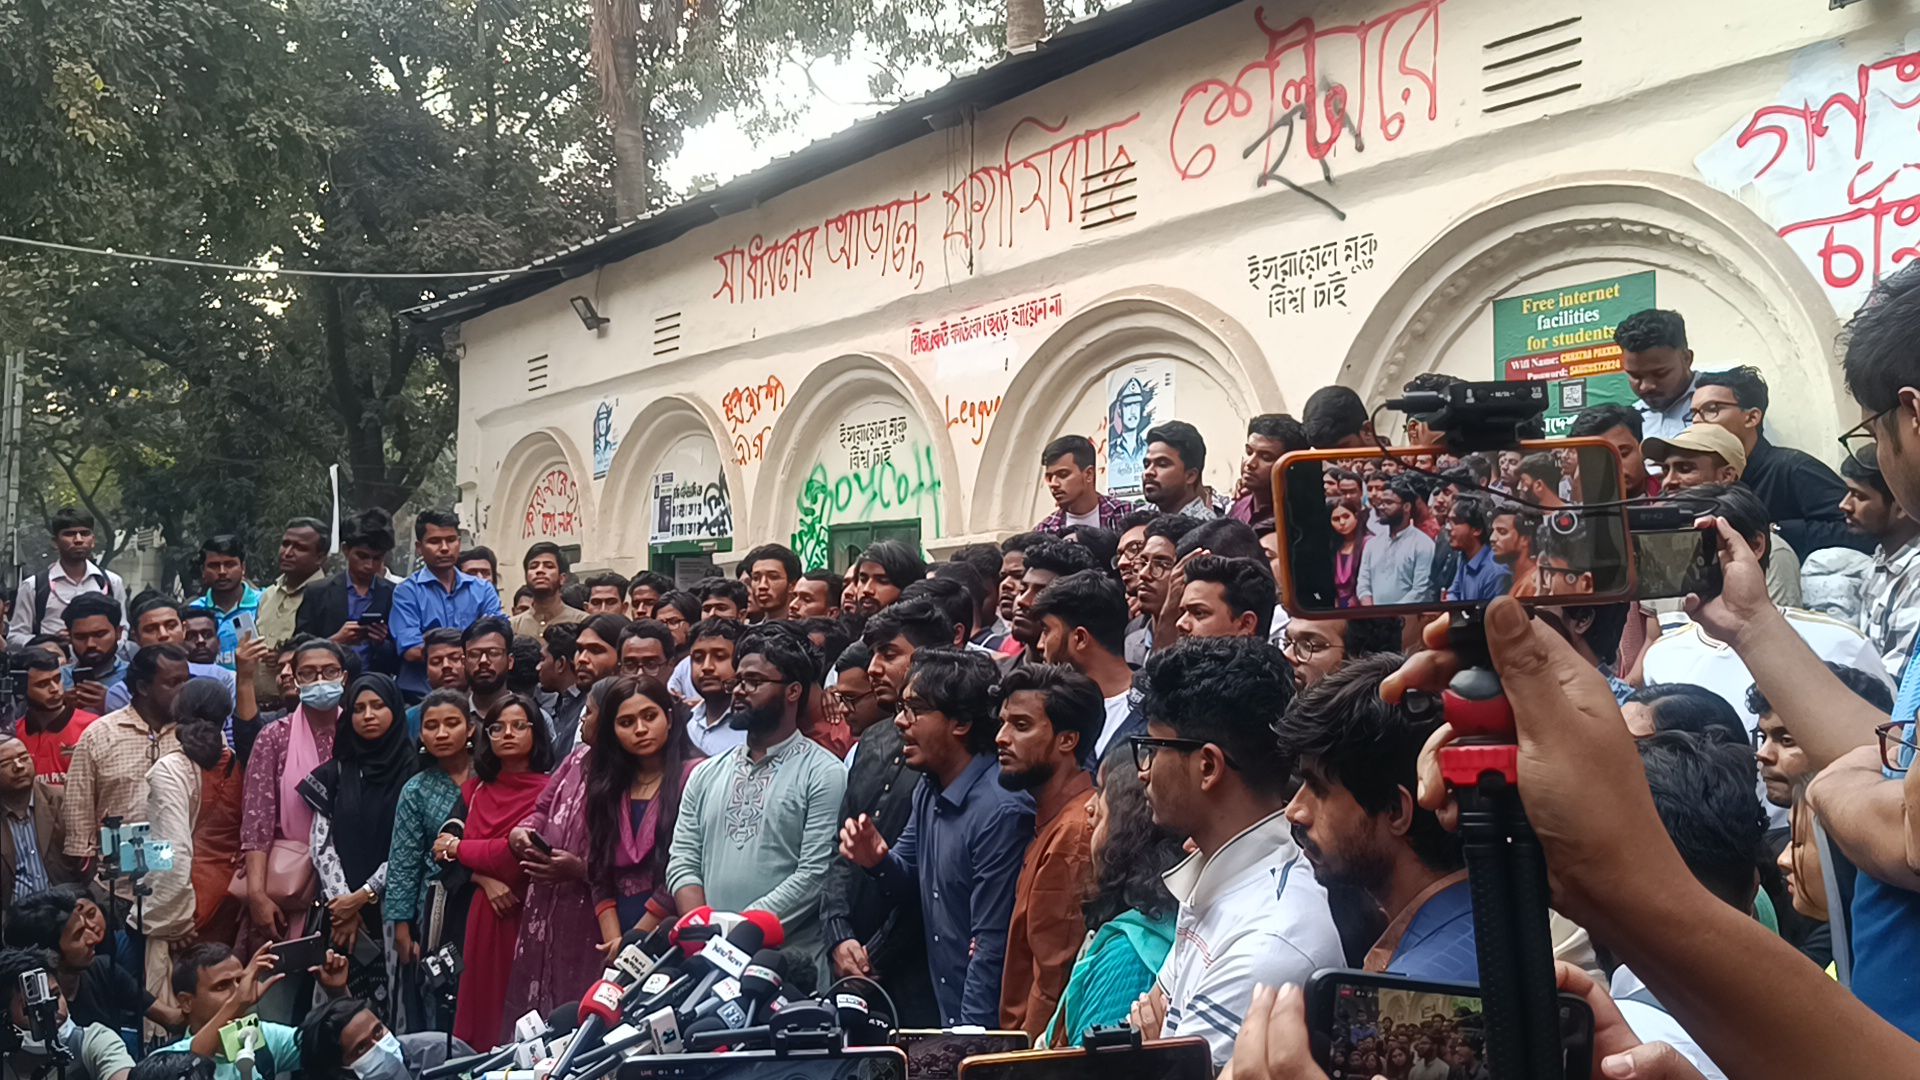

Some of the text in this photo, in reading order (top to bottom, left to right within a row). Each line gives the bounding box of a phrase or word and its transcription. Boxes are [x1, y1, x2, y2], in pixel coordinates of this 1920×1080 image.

[1314, 271, 1348, 307] চাই
[1522, 283, 1621, 315] Free internet
[1537, 308, 1601, 331] facilities
[1527, 325, 1617, 351] for students
